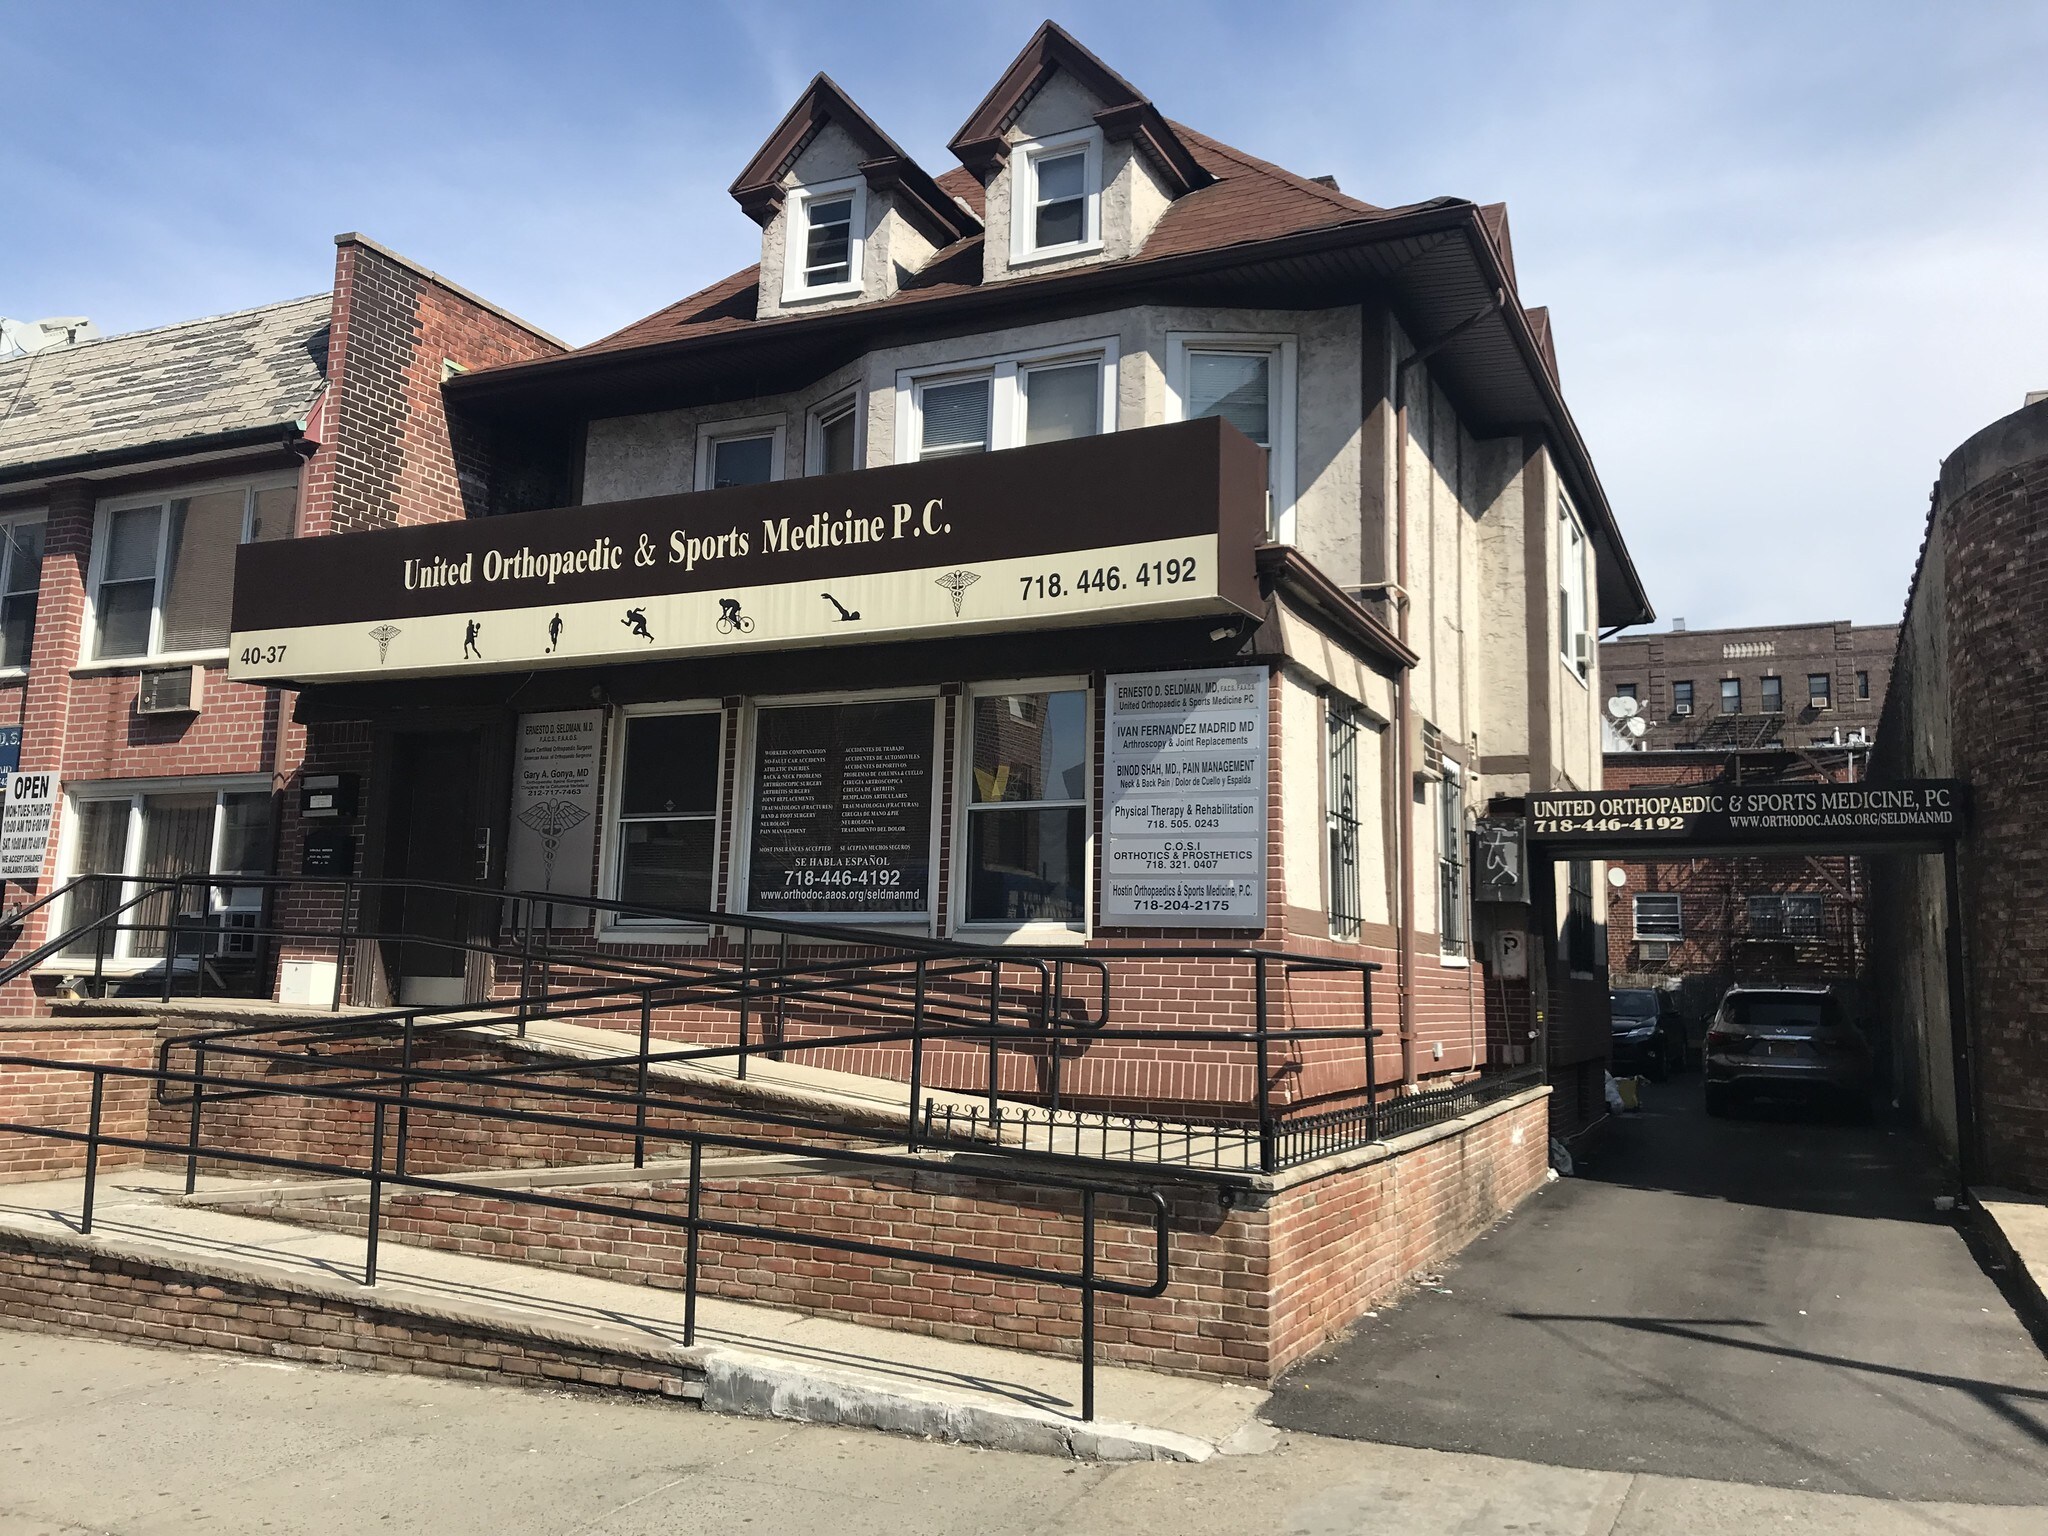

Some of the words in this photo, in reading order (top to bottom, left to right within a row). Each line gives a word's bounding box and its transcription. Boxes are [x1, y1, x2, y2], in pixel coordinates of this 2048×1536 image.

[404, 553, 472, 590] United
[483, 536, 623, 585] Orthopaedic
[634, 533, 656, 567] &
[669, 526, 749, 571] Sports
[762, 508, 885, 554] Medicine
[891, 498, 951, 540] P.C.
[1020, 573, 1068, 600] 718.
[1077, 566, 1127, 593] 446.
[1136, 557, 1196, 586] 4192
[241, 645, 286, 664] 40-37
[1119, 686, 1152, 698] ERNESTO
[1155, 686, 1162, 696] D.
[1120, 702, 1139, 710] United
[1142, 700, 1180, 709] Orthopaedic
[1189, 697, 1210, 708] Sports
[1213, 696, 1242, 705] Medicine
[1244, 694, 1253, 703] PC
[526, 725, 549, 735] ERNESTO
[550, 725, 555, 734] D.
[1118, 727, 1138, 737] IVAN
[1141, 723, 1196, 735] FERNANDEZ
[1199, 722, 1236, 733] MADRID
[1239, 721, 1254, 732] MD
[1123, 739, 1166, 749] Arthroscopy
[1169, 738, 1173, 747] &
[1176, 738, 1194, 746] Joint
[1196, 736, 1248, 747] Replacements
[524, 771, 540, 780] Gary
[551, 769, 574, 779] Gonya,
[1117, 765, 1140, 776] BINOD
[1141, 764, 1163, 776] SHAH,
[1183, 763, 1200, 774] PAIN
[1202, 760, 1254, 773] MANAGEMENT
[14, 776, 49, 799] OPEN
[1121, 779, 1134, 788] Neck
[1136, 779, 1140, 788] &
[1142, 779, 1156, 787] Back
[1158, 778, 1170, 786] Pain
[1175, 777, 1191, 786] Dolor
[1202, 776, 1220, 784] Cuello
[1222, 777, 1226, 786] y
[1227, 775, 1251, 785] Espalda
[1534, 800, 1595, 817] UNITED
[1600, 796, 1722, 816] ORTHOPAEDIC
[1729, 796, 1743, 812] &
[1748, 793, 1816, 811] SPORTS
[1822, 790, 1920, 810] MEDICINE,
[1925, 789, 1950, 807] PC
[1115, 806, 1148, 819] Physical
[1152, 805, 1184, 818] Therapy
[1187, 804, 1192, 815] &
[1196, 803, 1254, 815] Rehabilitation
[17, 820, 24, 832] AM
[26, 820, 31, 832] TO
[42, 819, 50, 831] PM
[1534, 816, 1684, 832] 718-446-4192
[1730, 811, 1952, 828] WWW.ORTHODOC.AAOS.ORG/SELDMANMD
[1164, 842, 1200, 850] C.O.S.I
[795, 858, 806, 866] SE
[810, 857, 842, 866] HABLA
[846, 854, 890, 866] ESPAÑOL
[784, 870, 900, 885] 718-446-4192
[761, 889, 919, 901] www.orthodoc.aaos.org/seldmanmd
[1113, 885, 1132, 896] Hostin
[1134, 885, 1176, 899] Orthopaedics
[1177, 885, 1182, 896] &
[1184, 885, 1204, 899] Sports
[1206, 884, 1237, 897] Medicine,
[1239, 884, 1252, 896] P.C.
[1134, 900, 1229, 911] 718-204-2175
